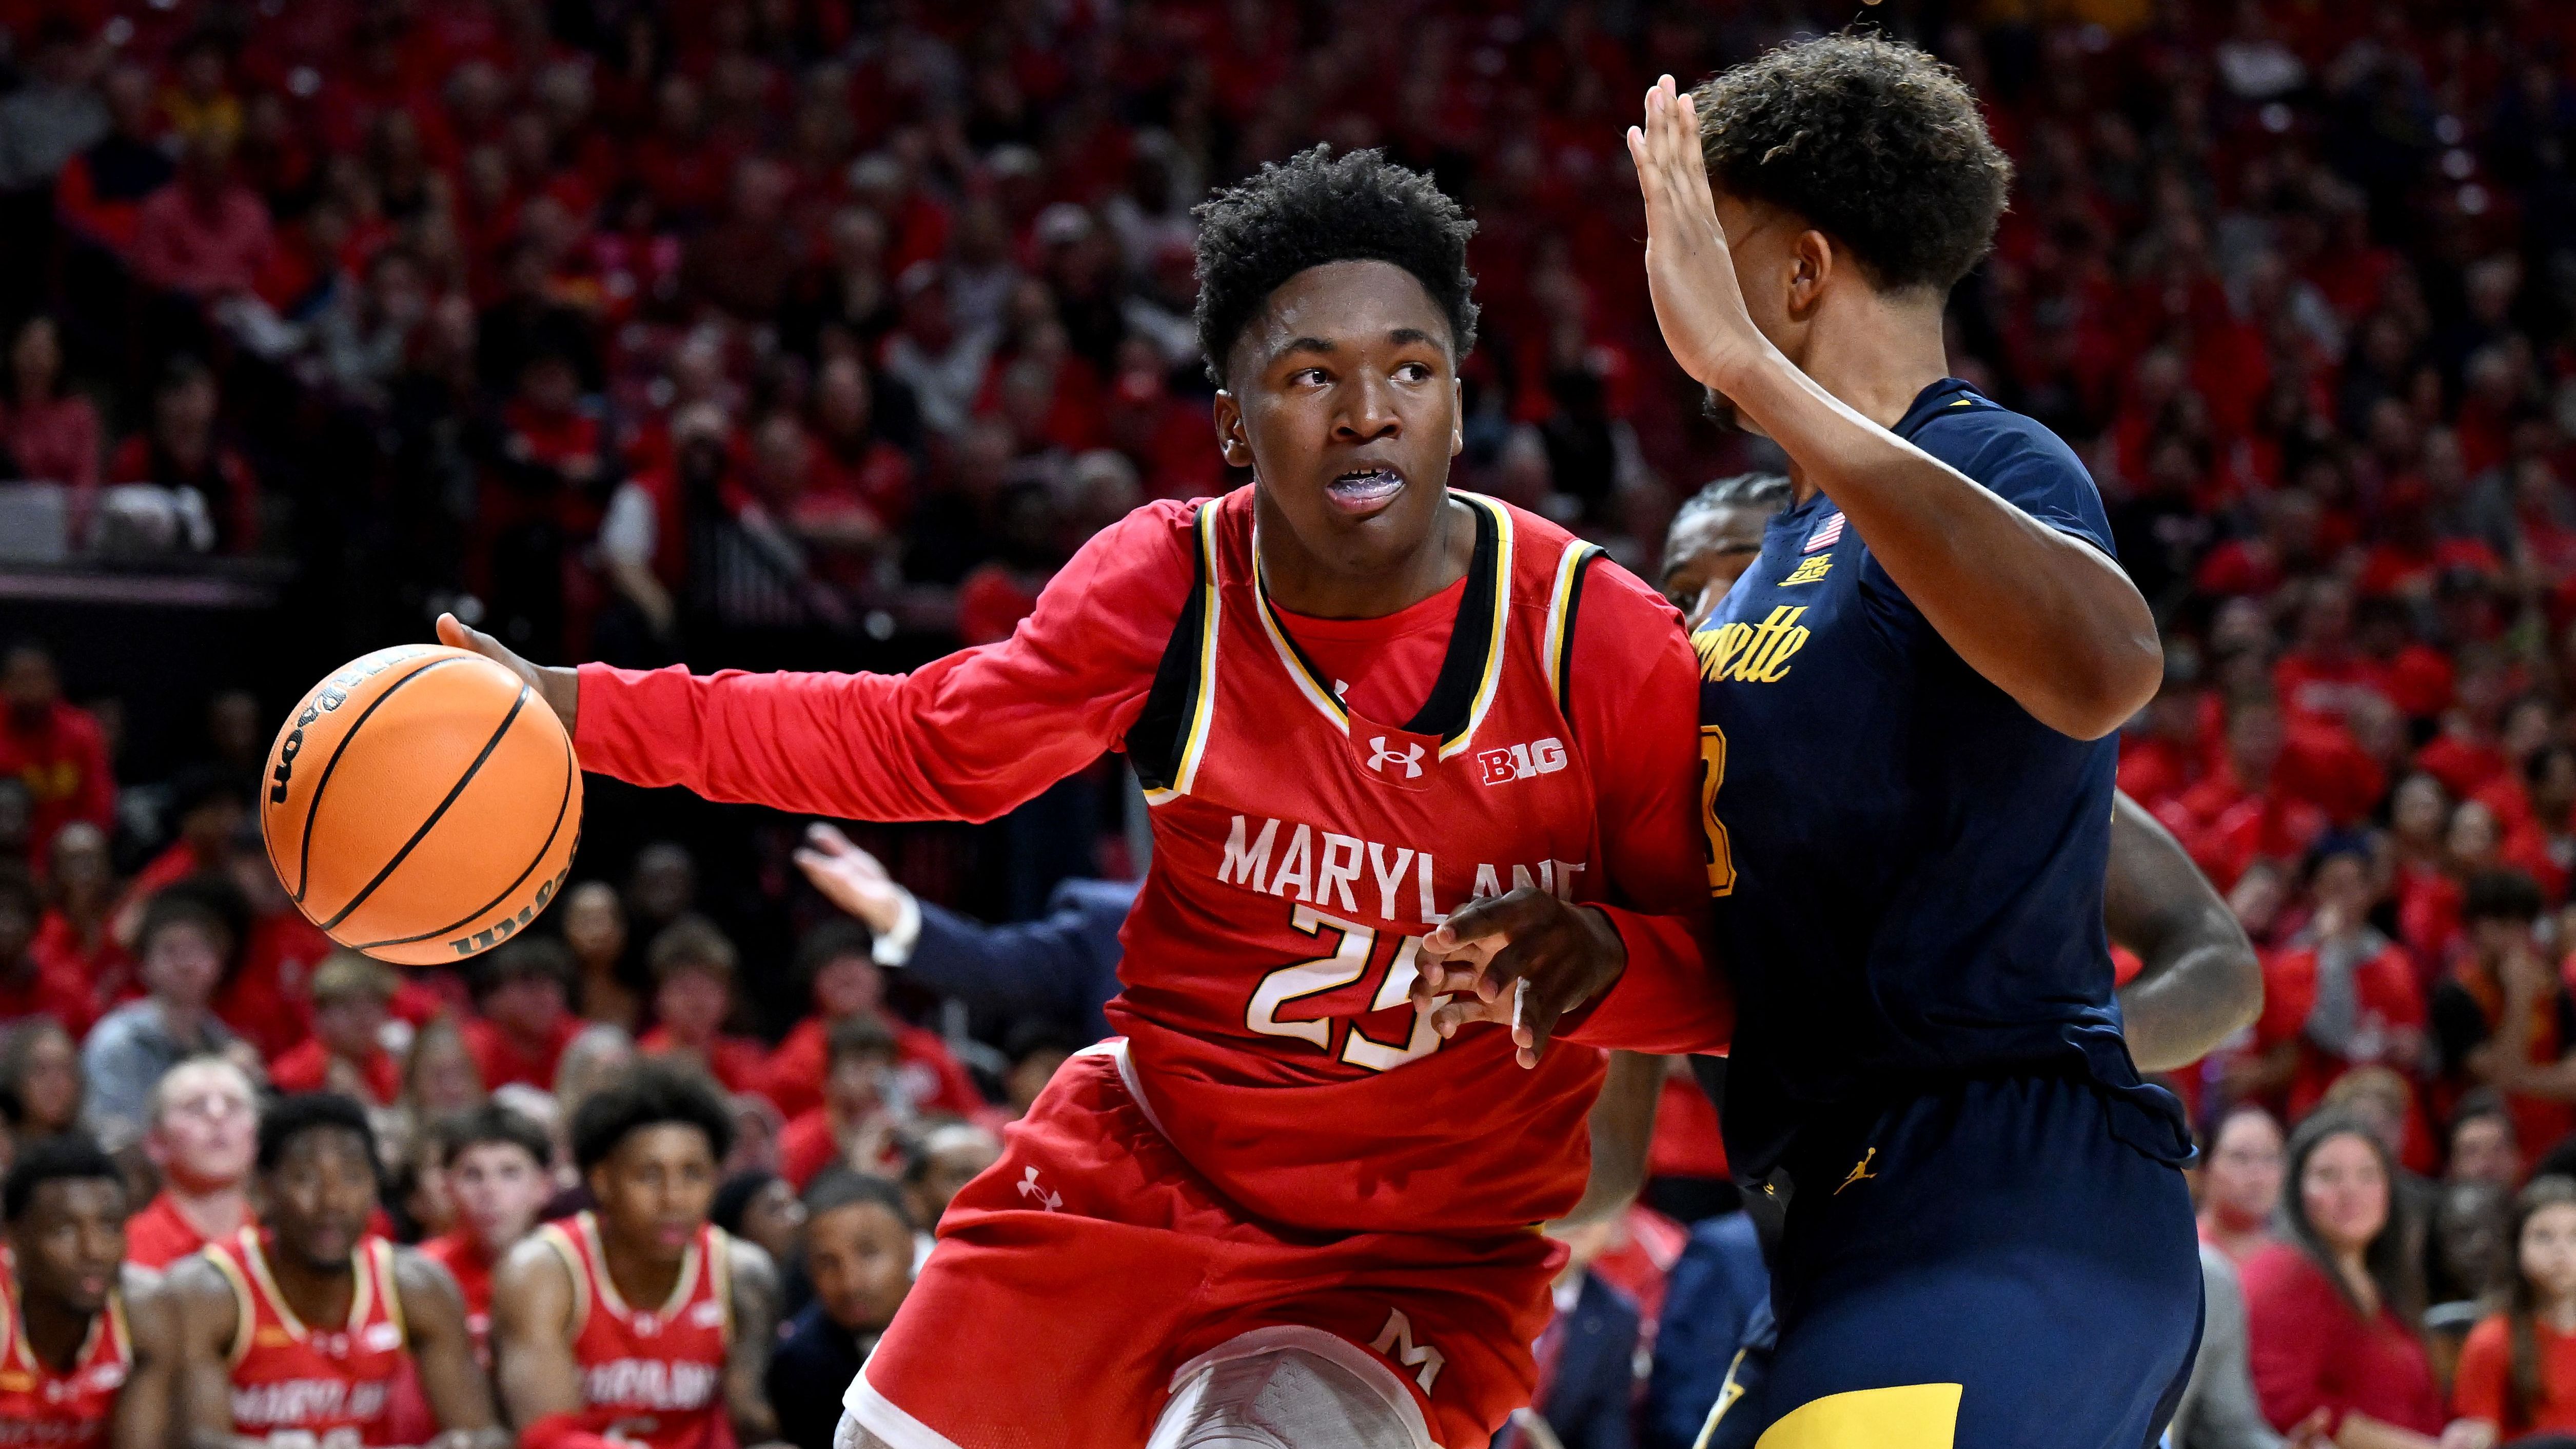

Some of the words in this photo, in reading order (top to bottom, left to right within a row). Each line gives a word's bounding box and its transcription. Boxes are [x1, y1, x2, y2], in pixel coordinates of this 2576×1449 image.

[1785, 563, 1834, 582] EAST
[1797, 553, 1833, 571] BIG
[1246, 904, 1455, 1072] 25
[1367, 1307, 1446, 1398] M
